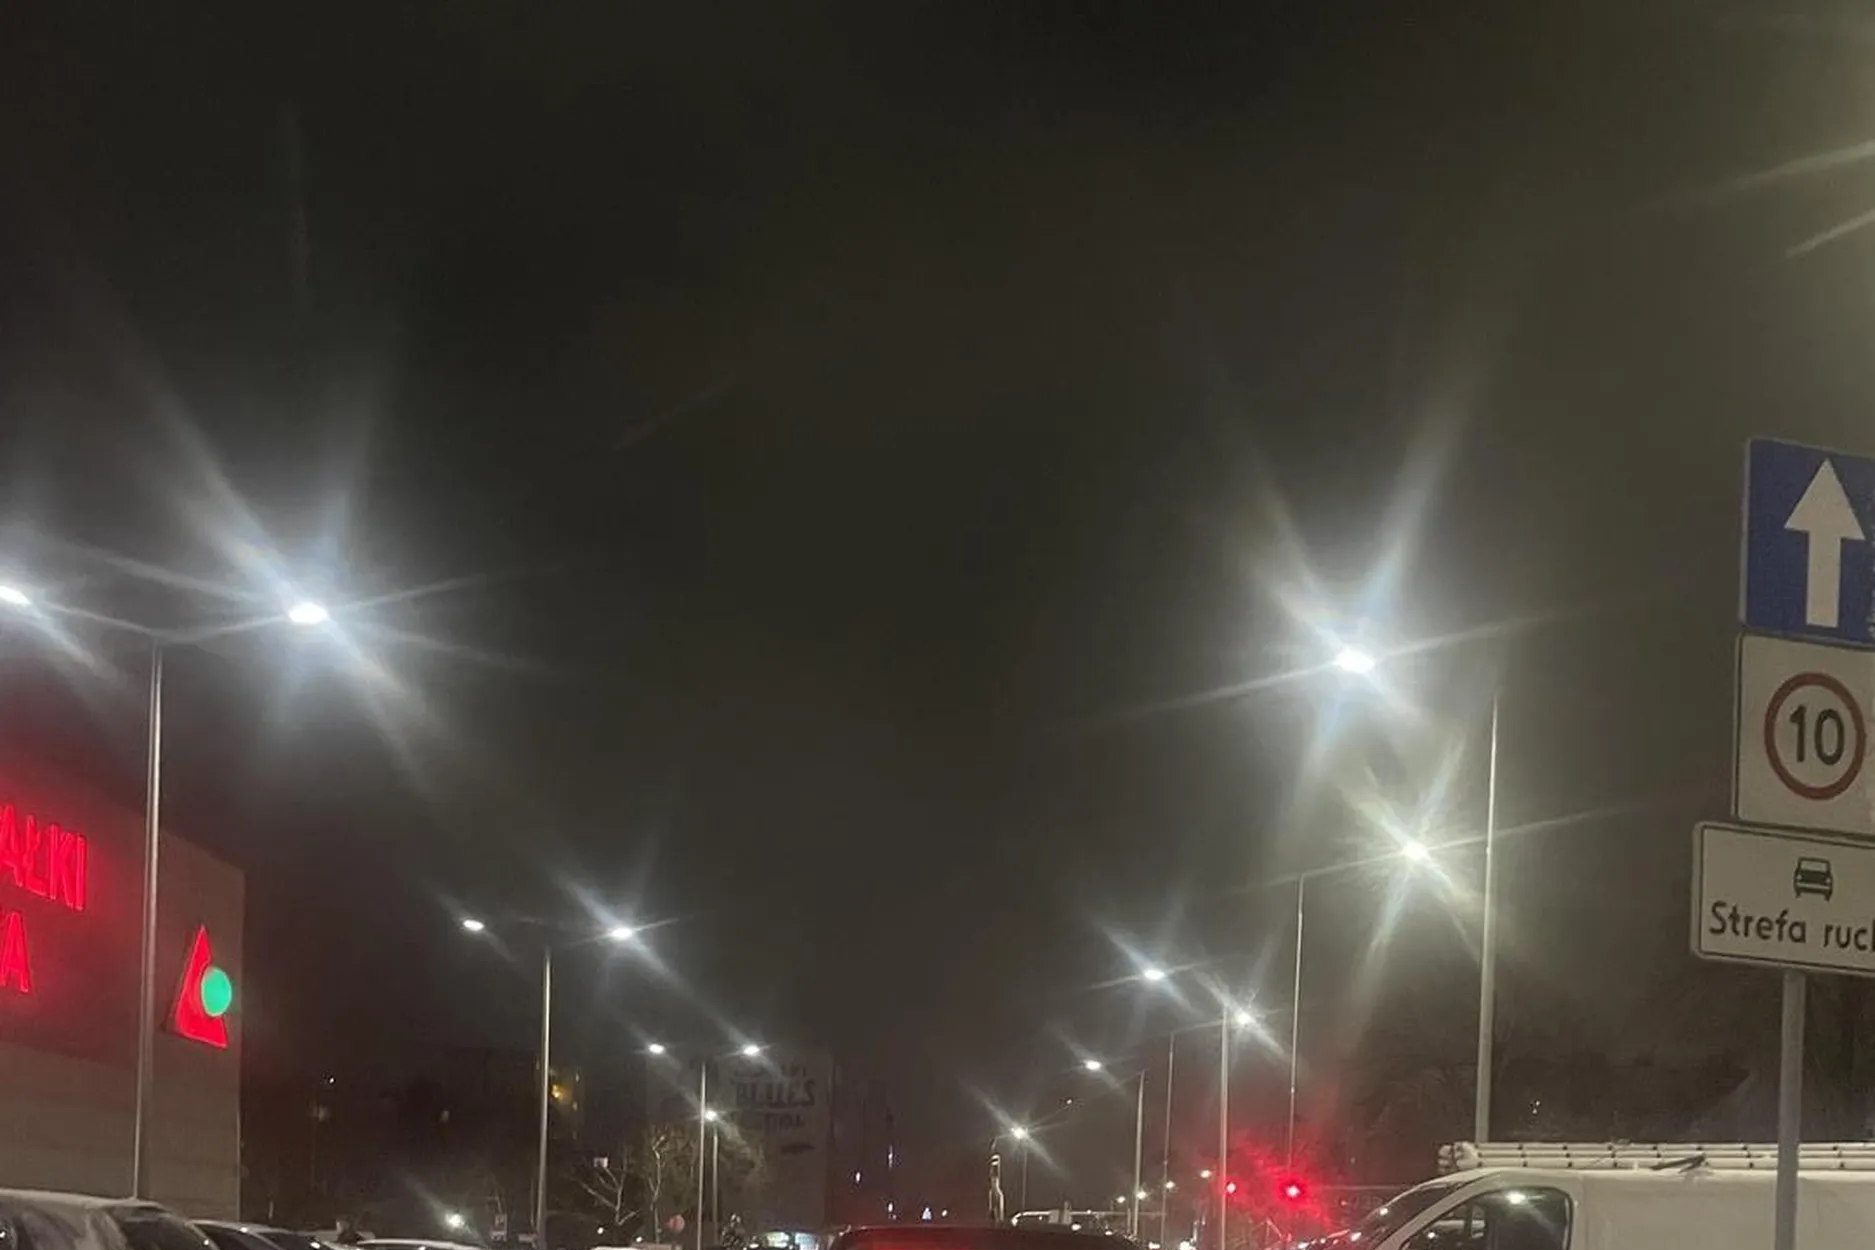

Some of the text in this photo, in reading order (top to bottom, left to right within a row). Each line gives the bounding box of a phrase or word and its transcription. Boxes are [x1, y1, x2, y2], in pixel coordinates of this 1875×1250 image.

[1788, 704, 1845, 766] 10
[1708, 900, 1875, 953] Strefa ruc
